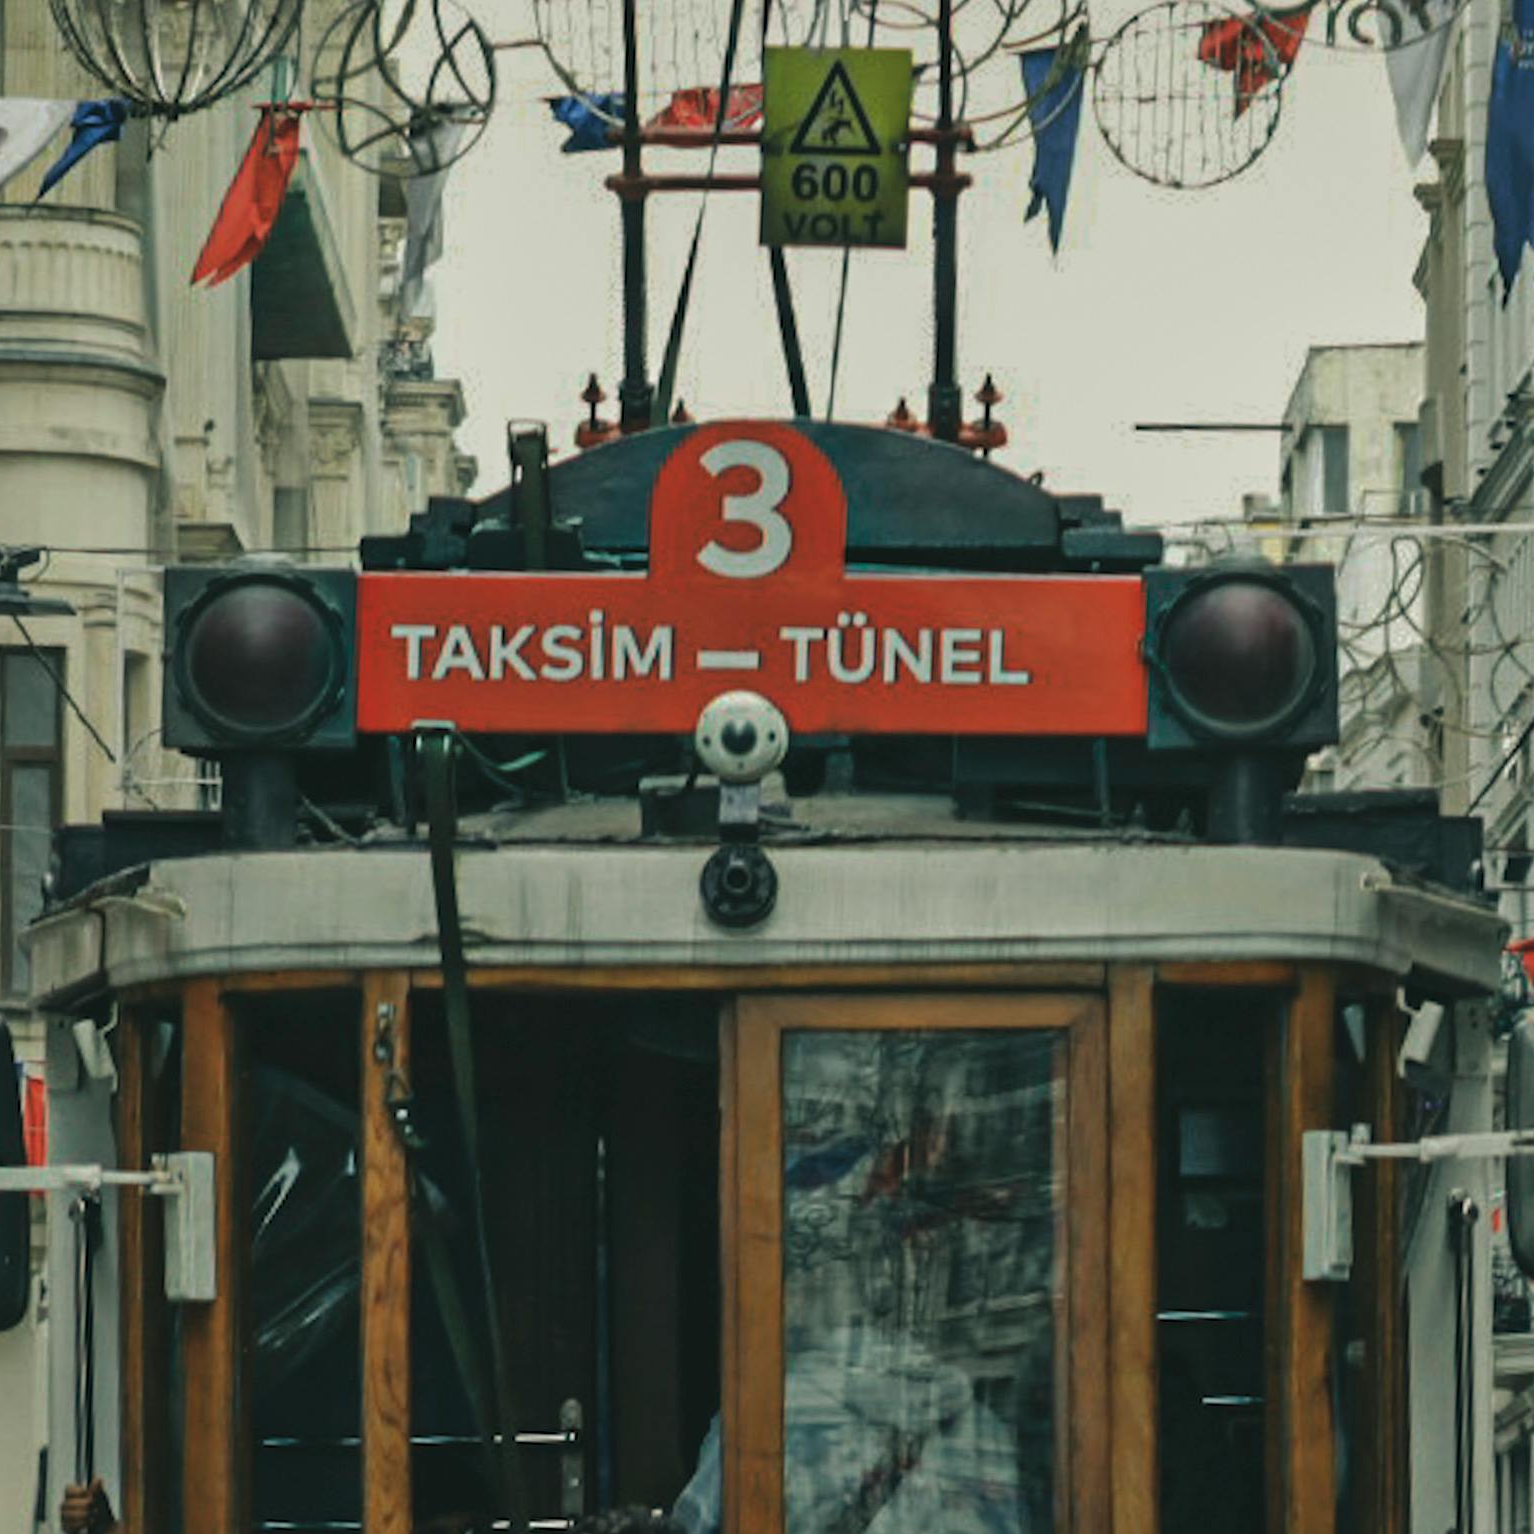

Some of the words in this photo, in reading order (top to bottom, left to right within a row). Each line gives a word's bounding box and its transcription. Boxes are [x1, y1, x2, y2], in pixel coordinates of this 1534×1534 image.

[792, 163, 880, 203] 600
[783, 211, 883, 241] VOLT
[696, 440, 793, 579] 3
[391, 610, 673, 681] TAKSİM
[780, 612, 1030, 684] TÜNEL
